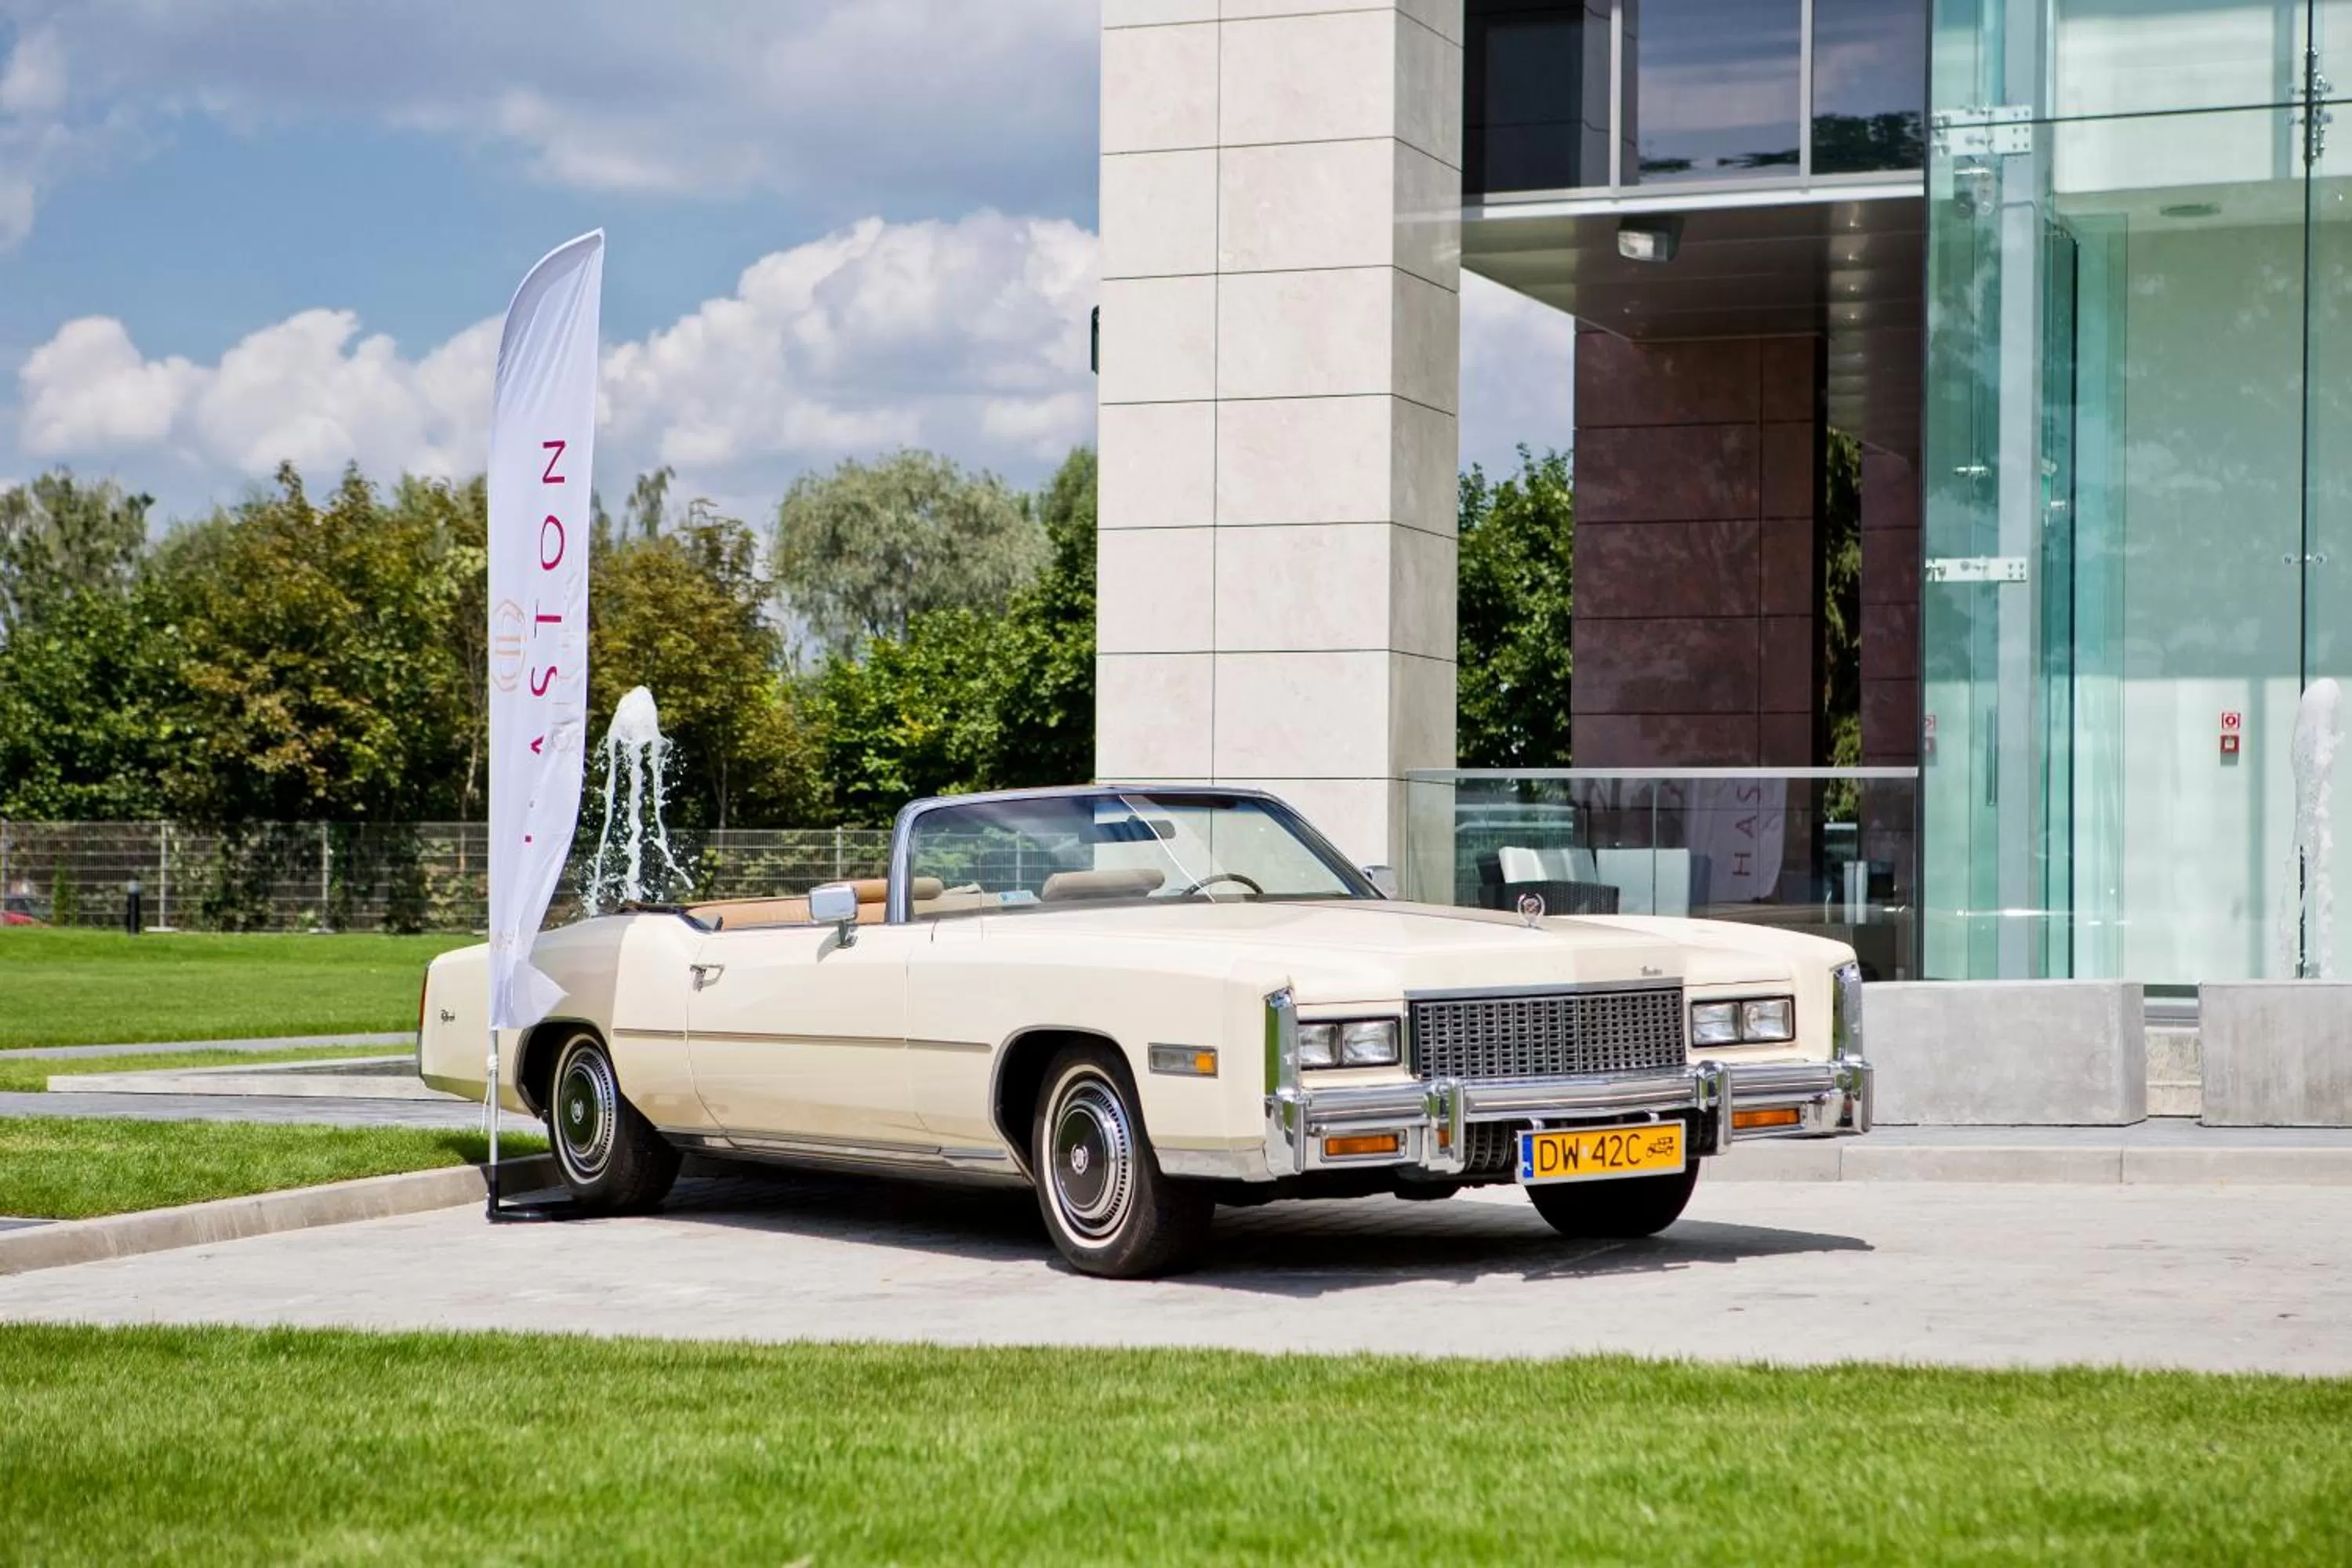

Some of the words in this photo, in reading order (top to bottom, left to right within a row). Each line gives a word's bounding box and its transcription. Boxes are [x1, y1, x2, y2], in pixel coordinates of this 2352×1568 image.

[524, 441, 565, 843] STON
[1539, 1138, 1580, 1172] DW
[1591, 1134, 1642, 1167] 42C
